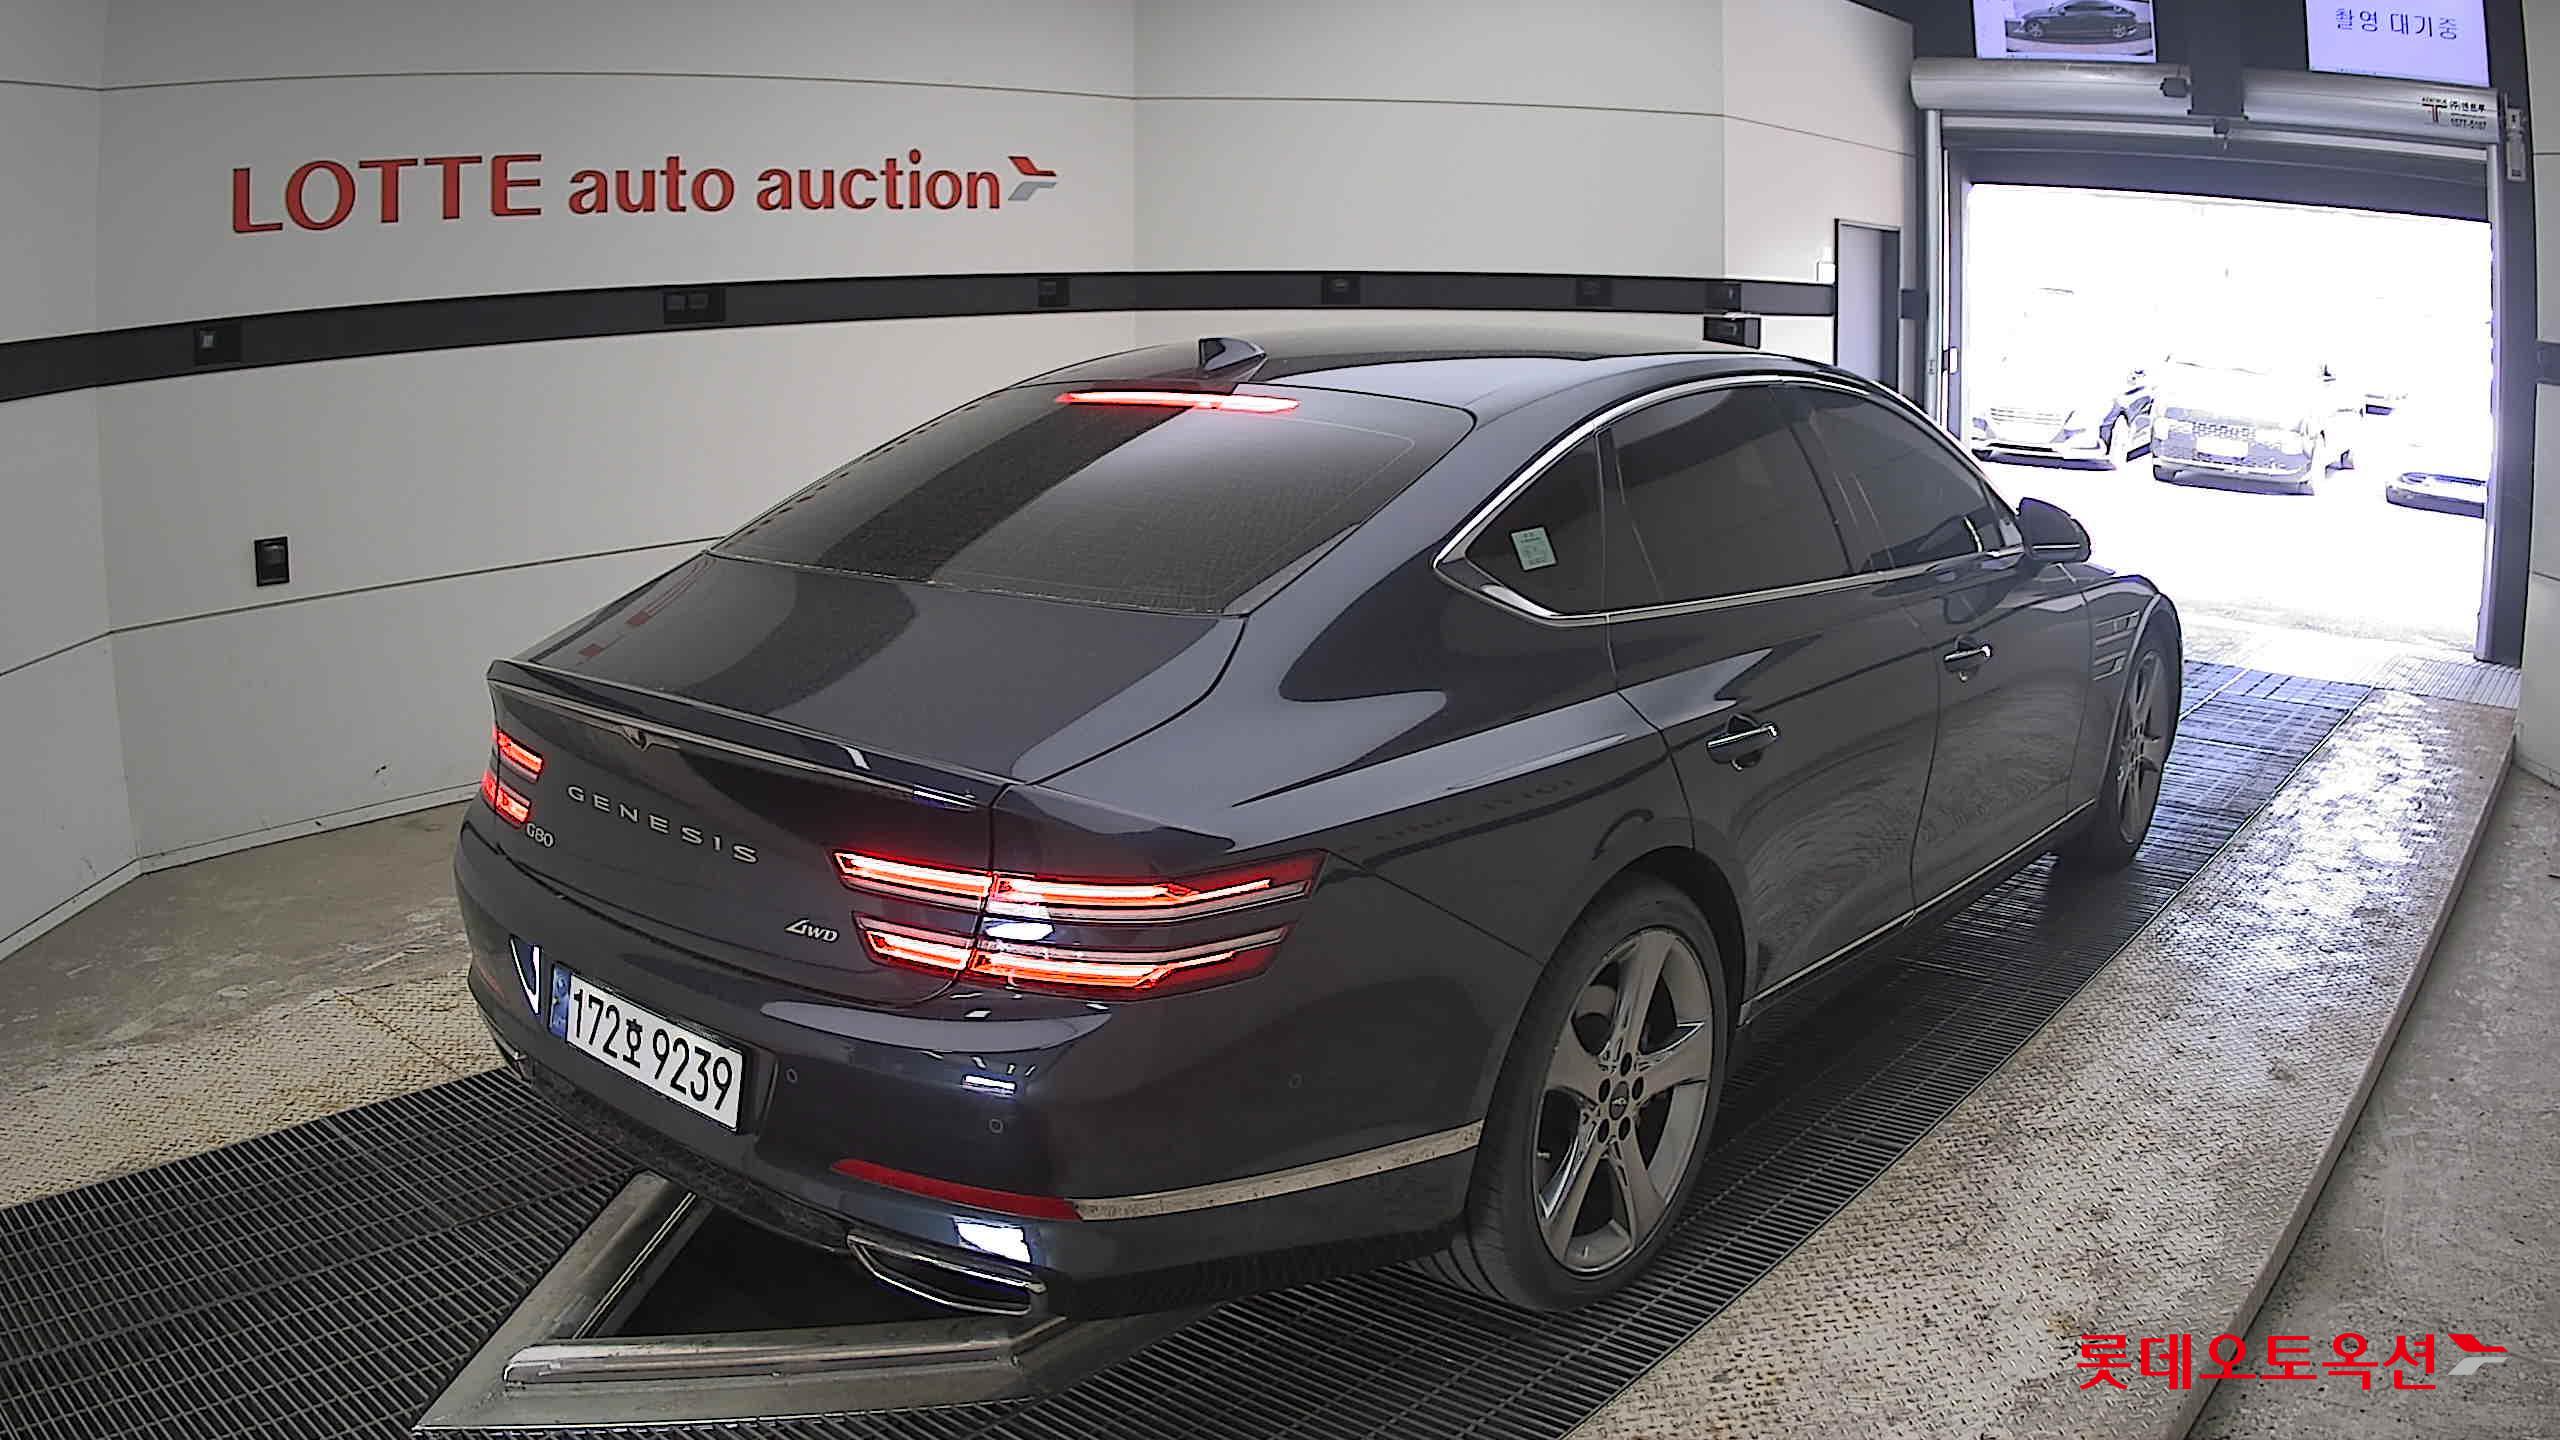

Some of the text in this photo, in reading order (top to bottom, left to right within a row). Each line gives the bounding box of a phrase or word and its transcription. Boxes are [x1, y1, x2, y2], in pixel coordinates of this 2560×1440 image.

[2336, 8, 2457, 40] 촬영 대기중
[233, 148, 1000, 233] LOTTE auto auction
[526, 822, 554, 848] G80
[567, 785, 759, 864] GENESIS
[784, 918, 839, 944] 4WD
[573, 988, 733, 1111] 172호 9239
